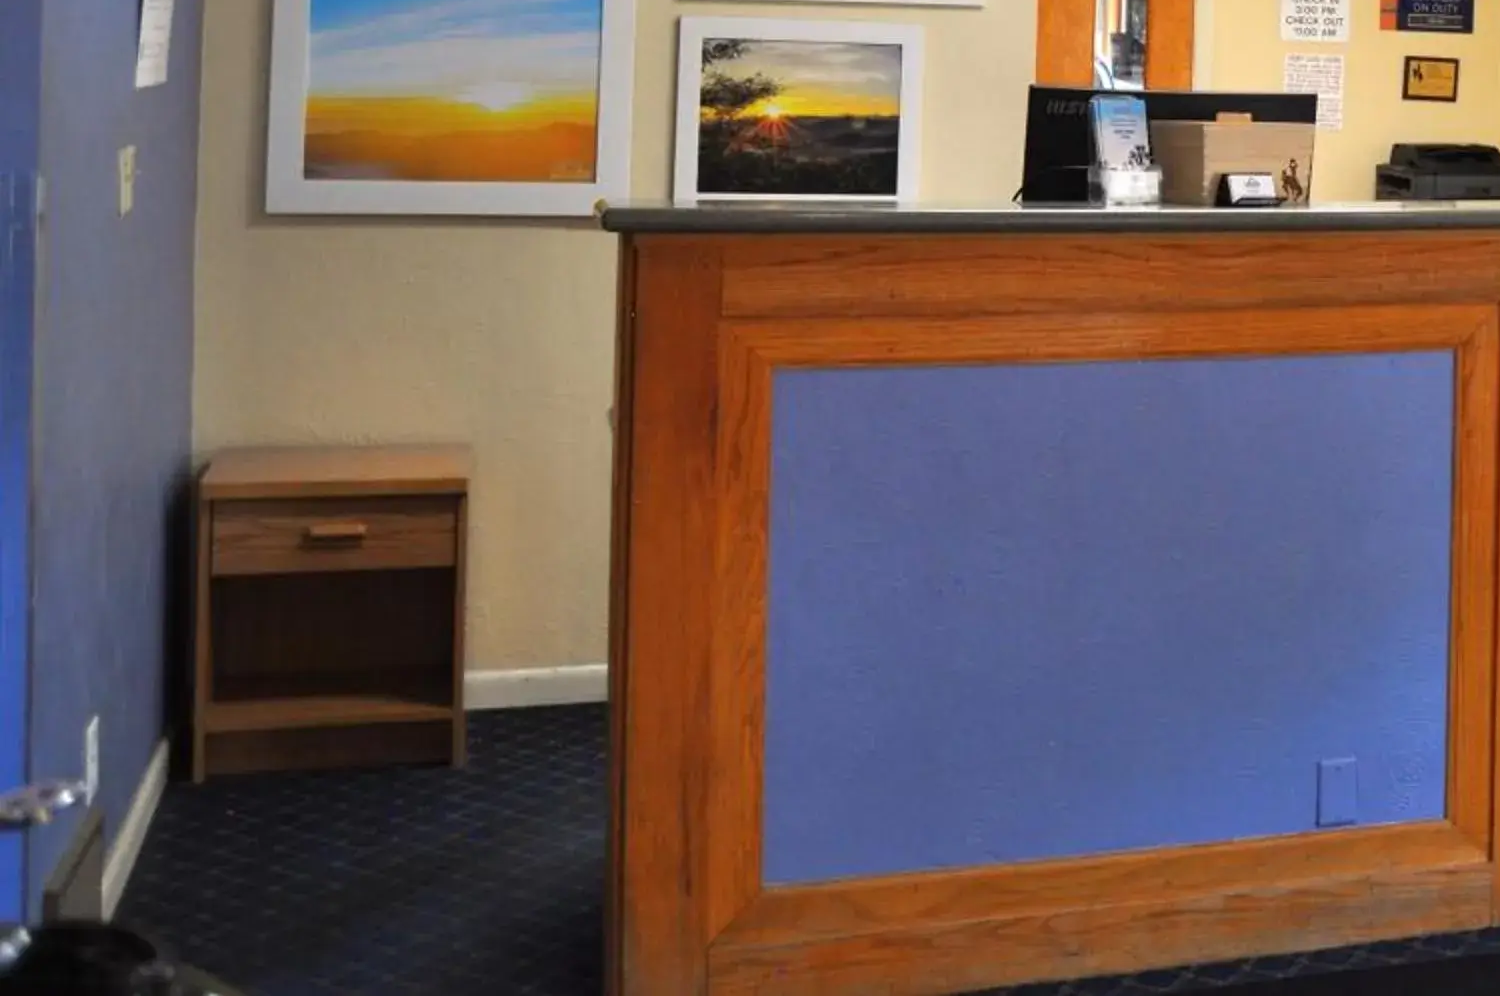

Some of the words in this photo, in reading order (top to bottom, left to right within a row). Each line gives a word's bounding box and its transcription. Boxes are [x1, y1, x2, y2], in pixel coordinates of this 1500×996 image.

[1413, 2, 1430, 13] ON
[1431, 2, 1460, 14] DUTY
[1285, 15, 1319, 25] CHECK
[1323, 17, 1344, 26] OUT
